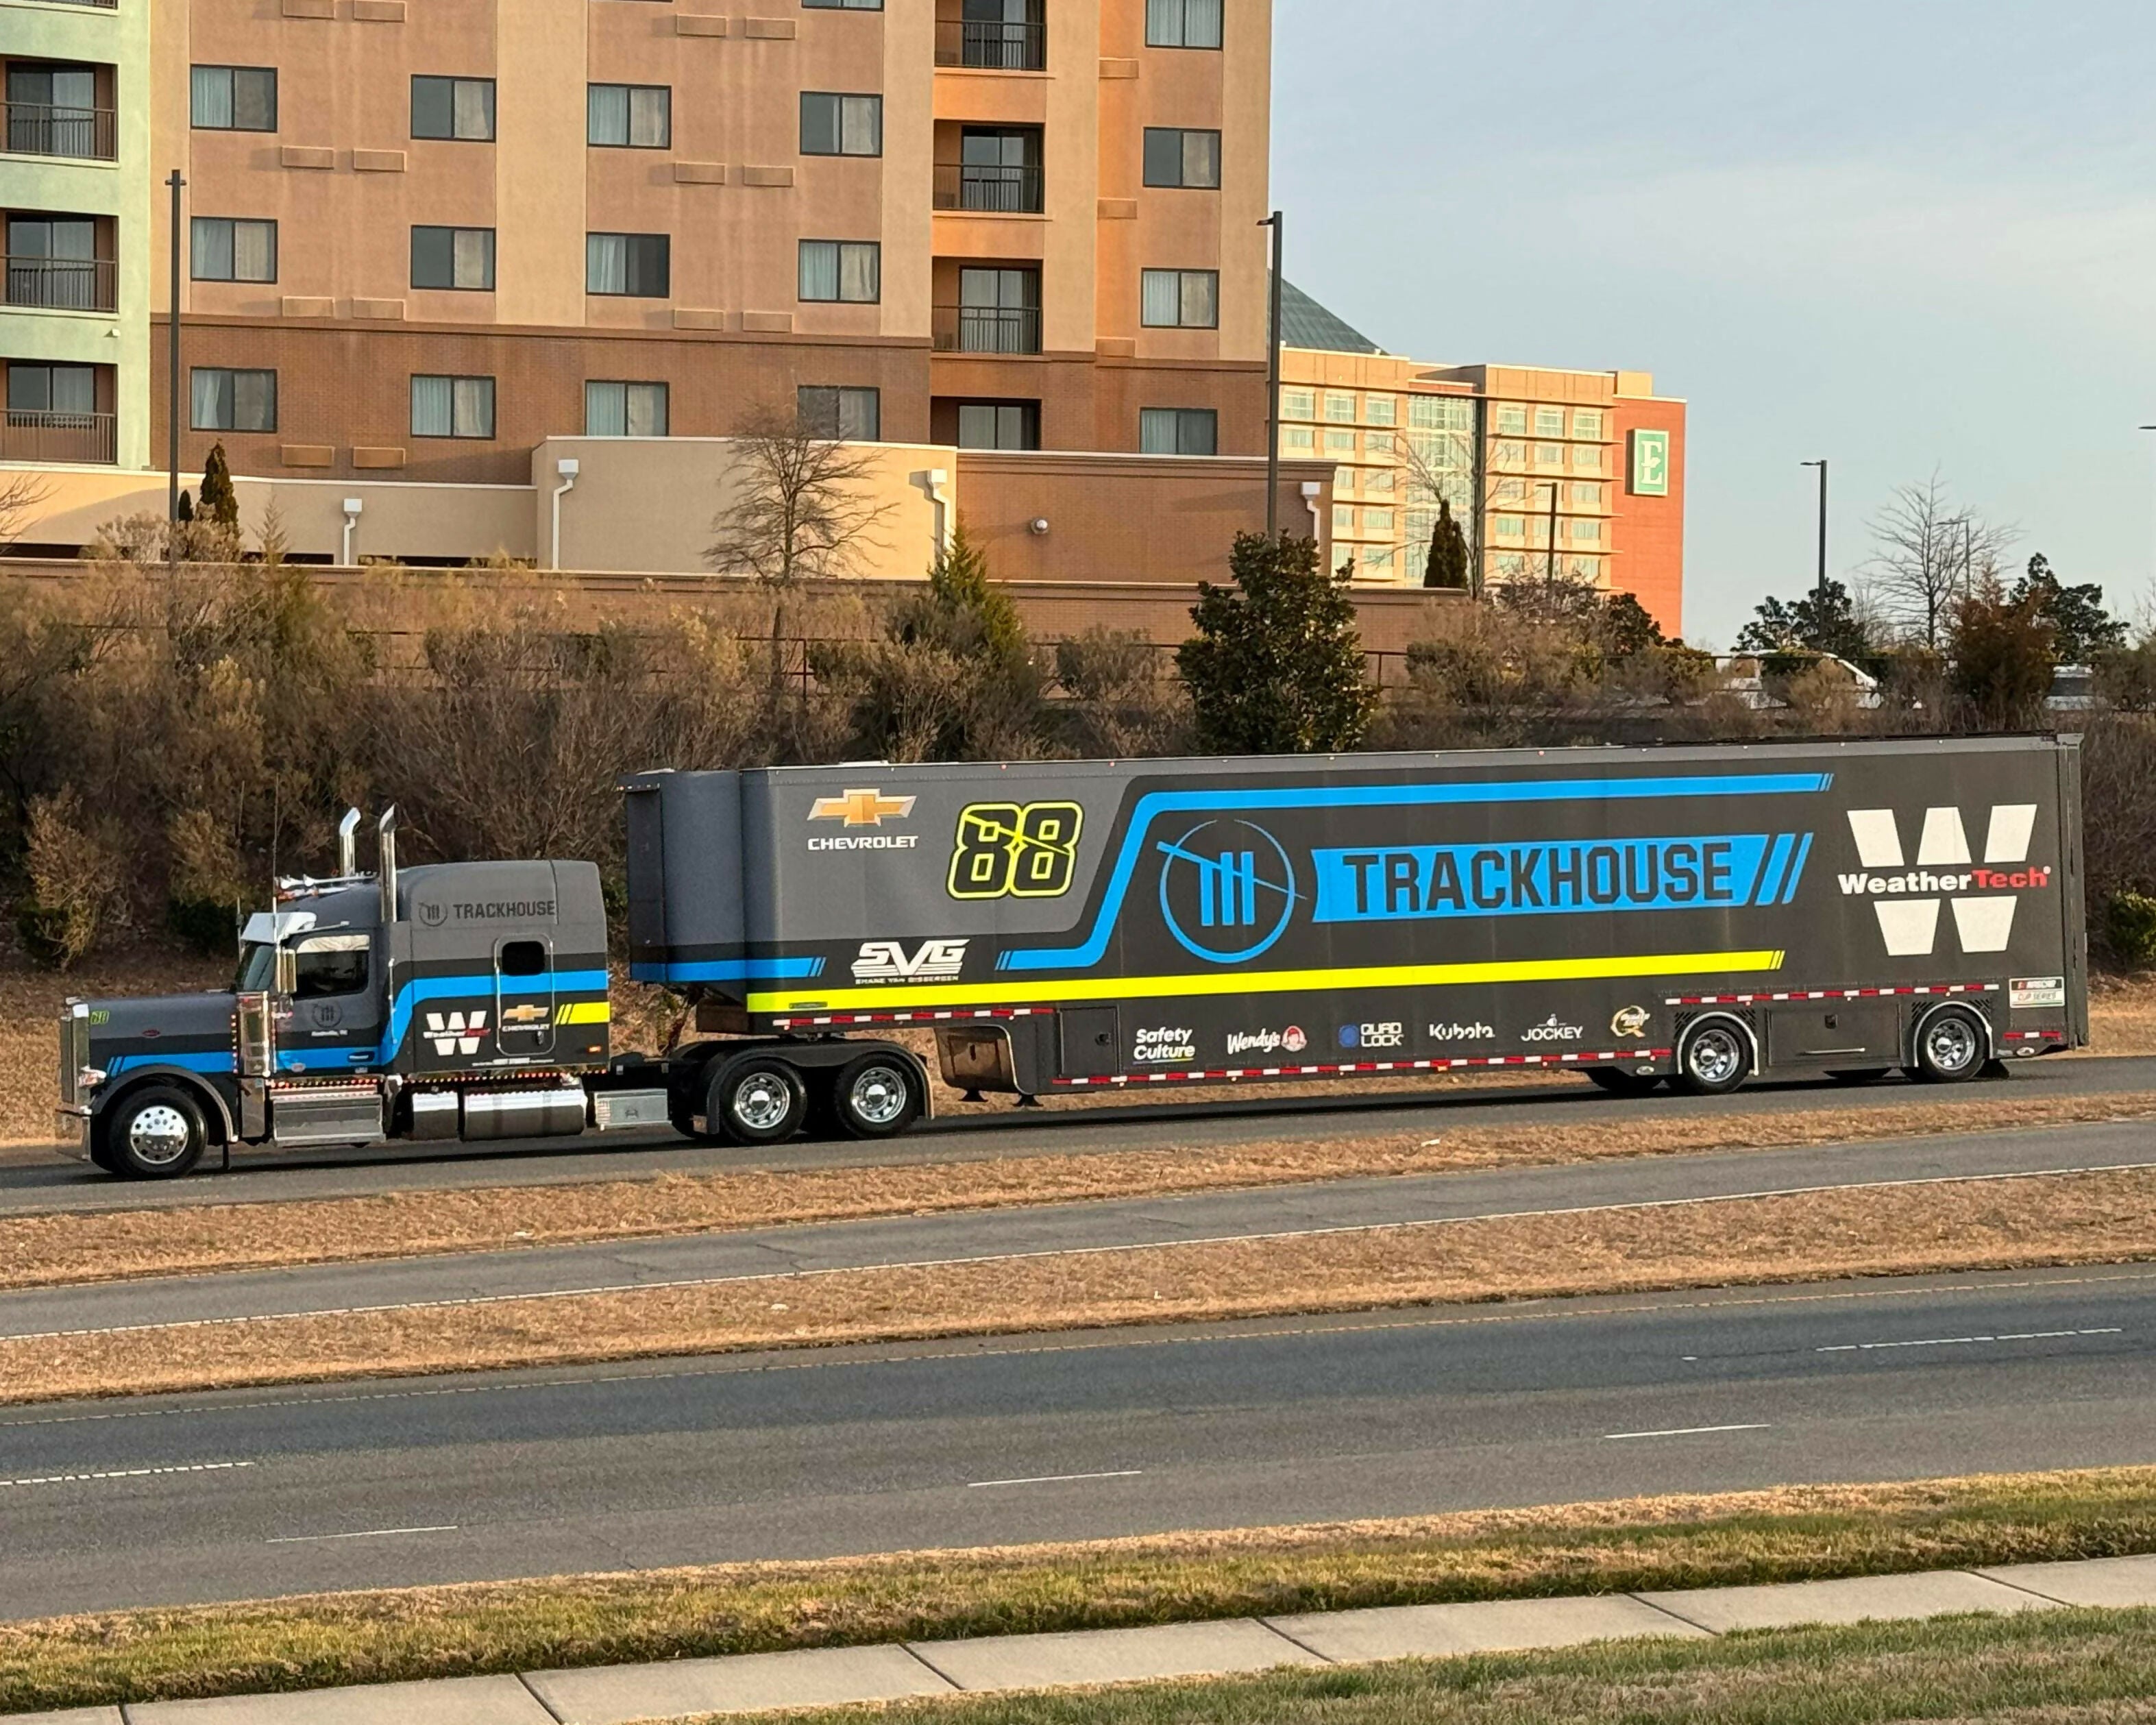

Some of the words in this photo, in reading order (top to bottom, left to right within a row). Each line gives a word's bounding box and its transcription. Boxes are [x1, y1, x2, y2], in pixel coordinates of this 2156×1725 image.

[1641, 440, 1663, 485] E
[807, 835, 919, 851] CHEVROLET
[948, 802, 1083, 898] 88
[1342, 842, 1734, 914] TRACKHOUSE
[1837, 866, 2048, 895] WeatherTech
[452, 900, 555, 920] TRACKHOUSE
[851, 939, 970, 977] SVG
[1136, 1027, 1193, 1045] Safety
[1360, 1023, 1403, 1036] QUAD
[1429, 1022, 1493, 1041] Kubota
[1521, 1025, 1584, 1042] JOCKEY
[1227, 1028, 1281, 1055] Wendy's
[1360, 1034, 1404, 1048] LOCK
[1133, 1043, 1196, 1060] Culture
